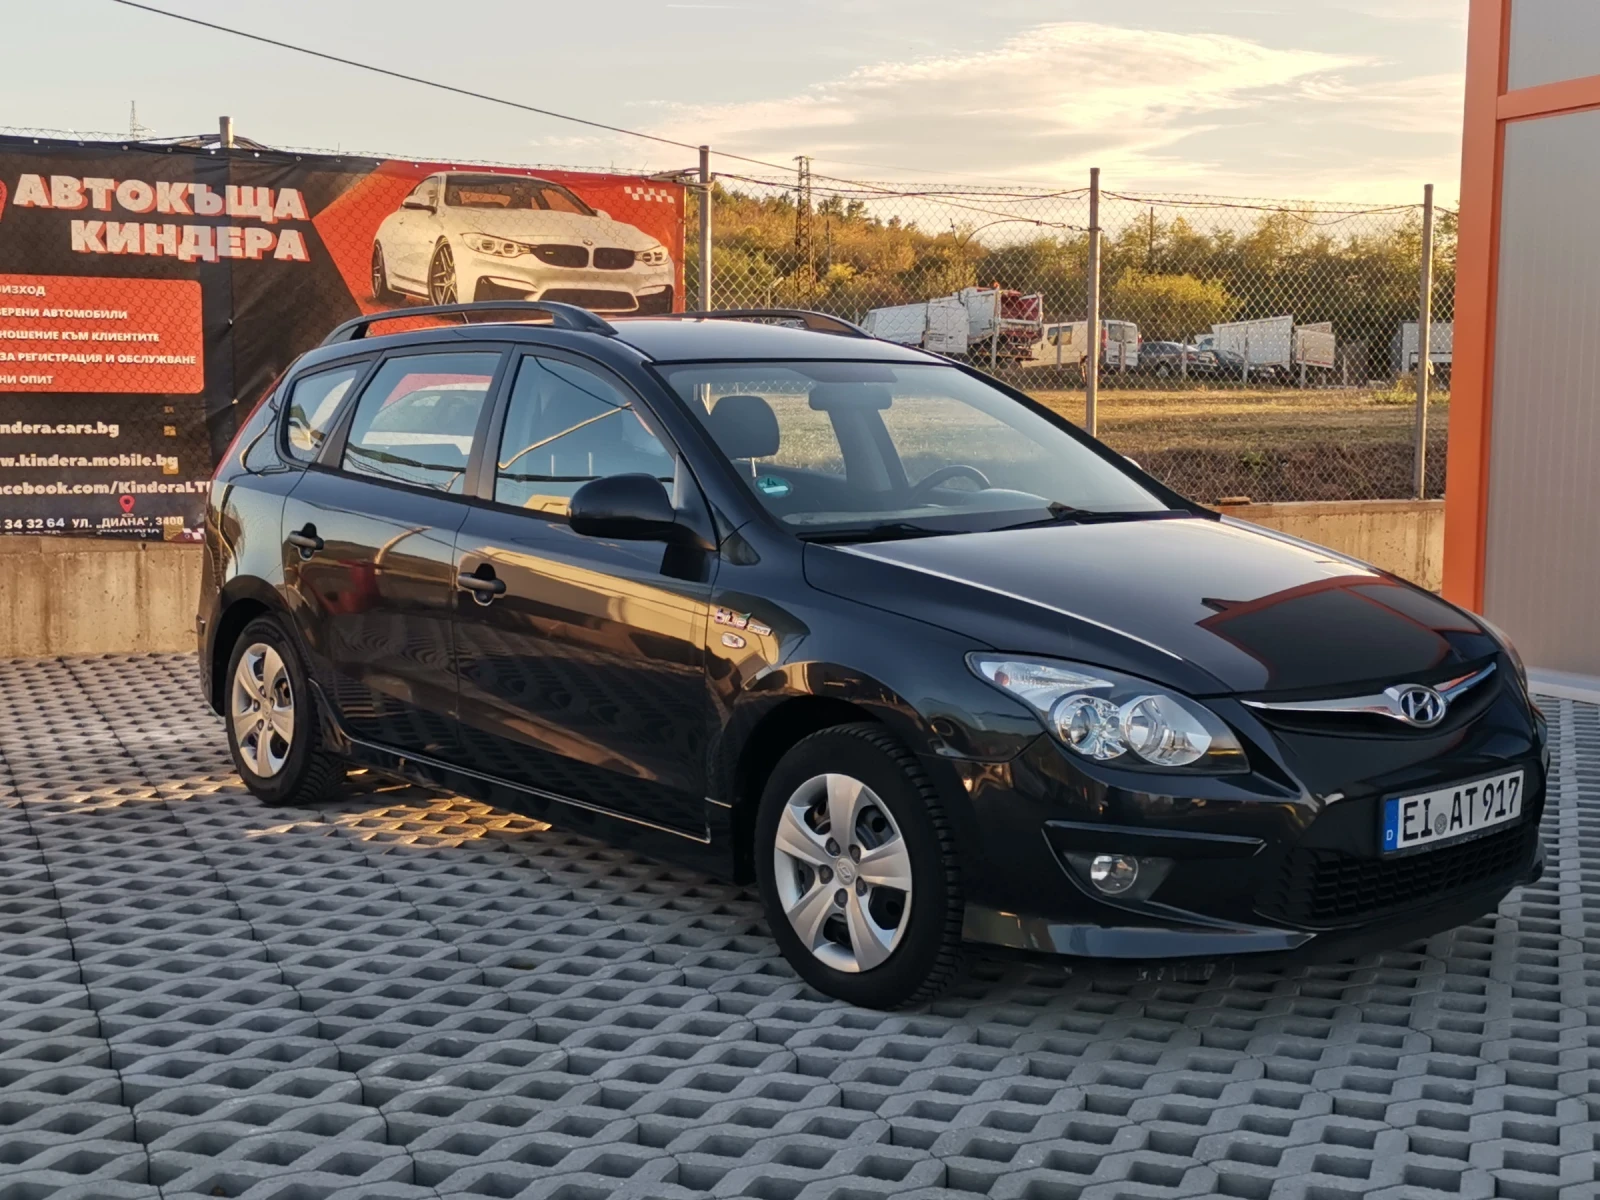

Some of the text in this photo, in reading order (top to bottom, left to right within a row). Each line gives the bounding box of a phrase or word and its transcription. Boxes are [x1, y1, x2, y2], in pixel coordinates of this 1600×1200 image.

[13, 173, 309, 223] АВТОКЪЩА
[71, 220, 309, 262] КИНДЕРА
[0, 285, 46, 296] ИЗХОД
[0, 307, 128, 319] ЕРЕНИ АВТОМОБИЛИ
[62, 331, 89, 341] КЪМ
[92, 333, 160, 342] КЛИЕНТИТЕ
[0, 352, 197, 364] ЗА РЕГИСТРАЦИЯ И ОБСЛУЖВАНЕ
[19, 375, 54, 384] ОПИТ
[0, 421, 120, 438] ndera.cars.bg
[0, 480, 211, 495] cebook.com/KinderaLT
[4, 519, 23, 530] 34
[26, 519, 44, 529] 32
[46, 518, 65, 528] 64
[71, 518, 93, 529] УЛ.
[155, 517, 184, 526] 3400
[1403, 798, 1432, 841] EI
[1450, 787, 1478, 831] AT
[1483, 776, 1520, 821] 917
[1386, 829, 1393, 841] D
